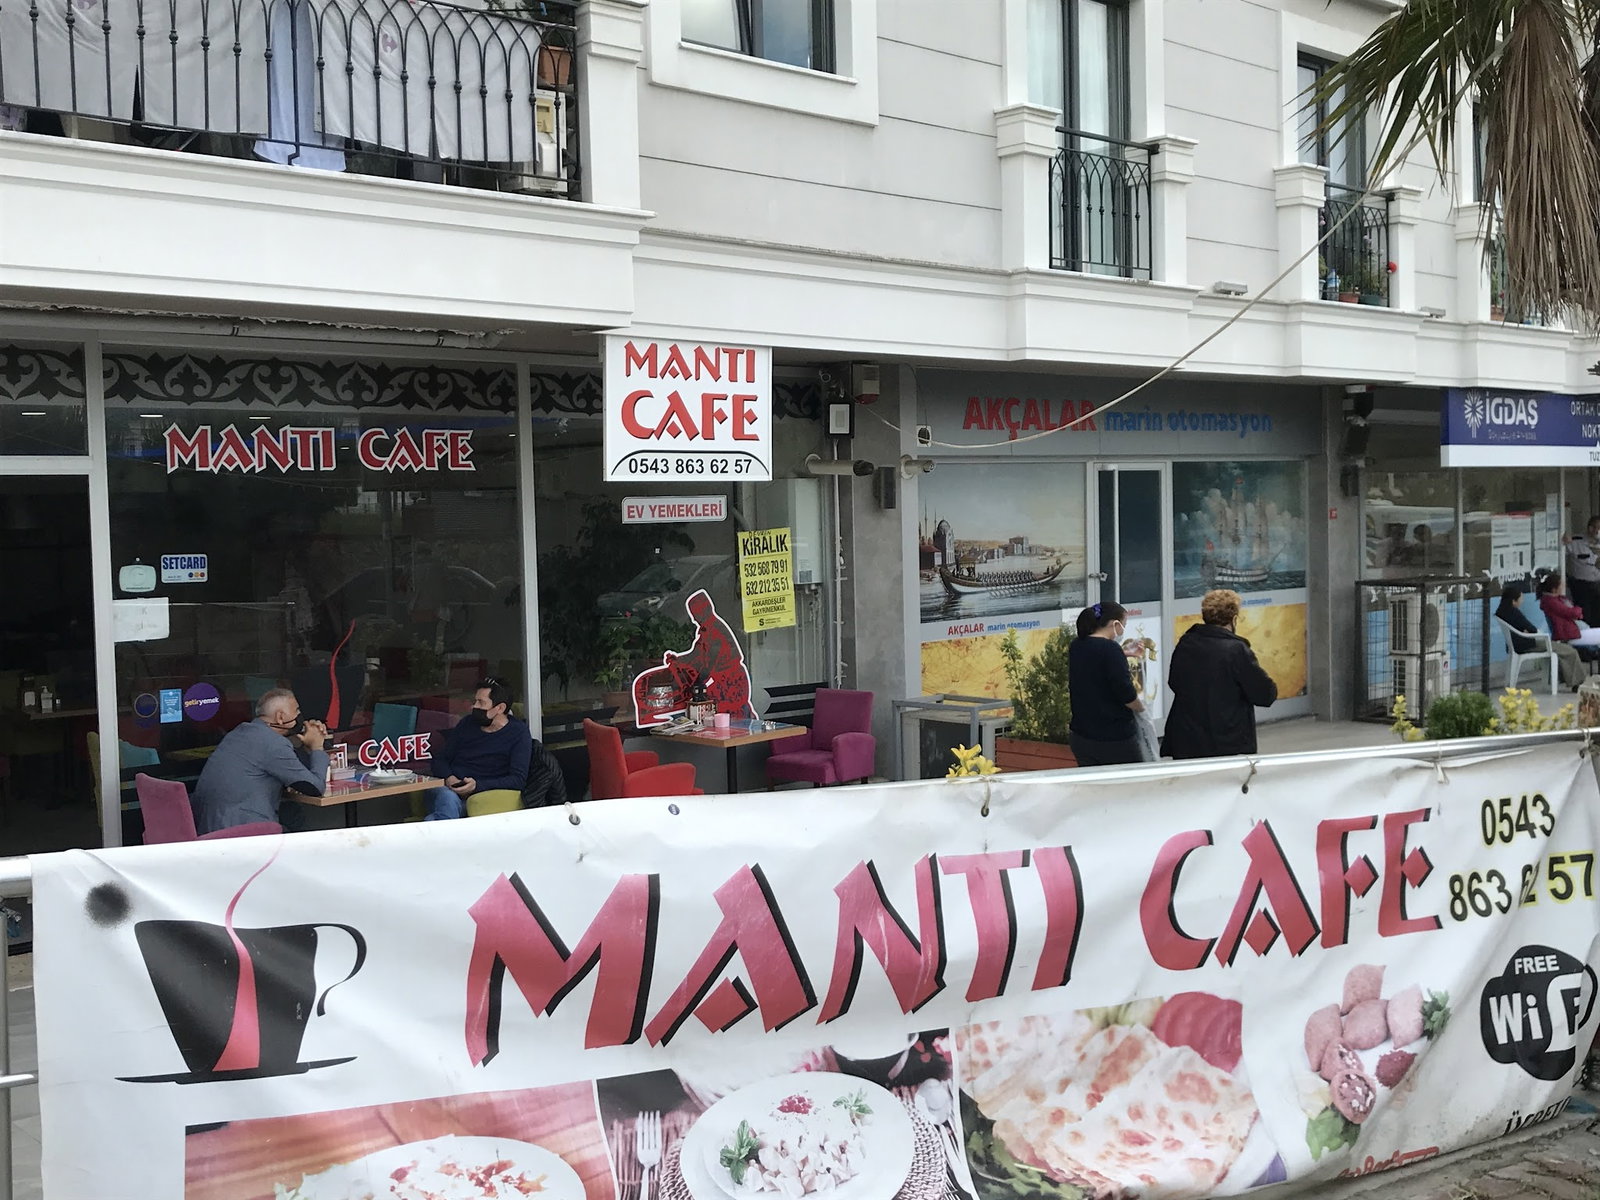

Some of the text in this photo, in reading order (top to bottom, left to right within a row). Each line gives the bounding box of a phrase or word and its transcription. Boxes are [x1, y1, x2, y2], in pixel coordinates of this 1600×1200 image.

[624, 340, 756, 383] MANTI
[621, 389, 760, 441] CAFE
[962, 396, 1273, 441] AKÇALAR marin otomasyon
[1486, 391, 1539, 429] İGDAŞ
[162, 422, 476, 474] MANTI CAFE
[628, 458, 752, 474] 0543 863 62 57
[626, 499, 723, 519] EV YEMEKLERİ
[162, 556, 206, 570] SETCARD
[760, 579, 771, 594] 212
[947, 622, 985, 636] AKÇALAR
[358, 732, 432, 766] CAFE
[1481, 793, 1555, 846] 0543
[1449, 868, 1513, 922] 863
[1548, 853, 1594, 900] 57
[465, 807, 1442, 1068] MANTI CAFE
[1515, 955, 1560, 974] FREE
